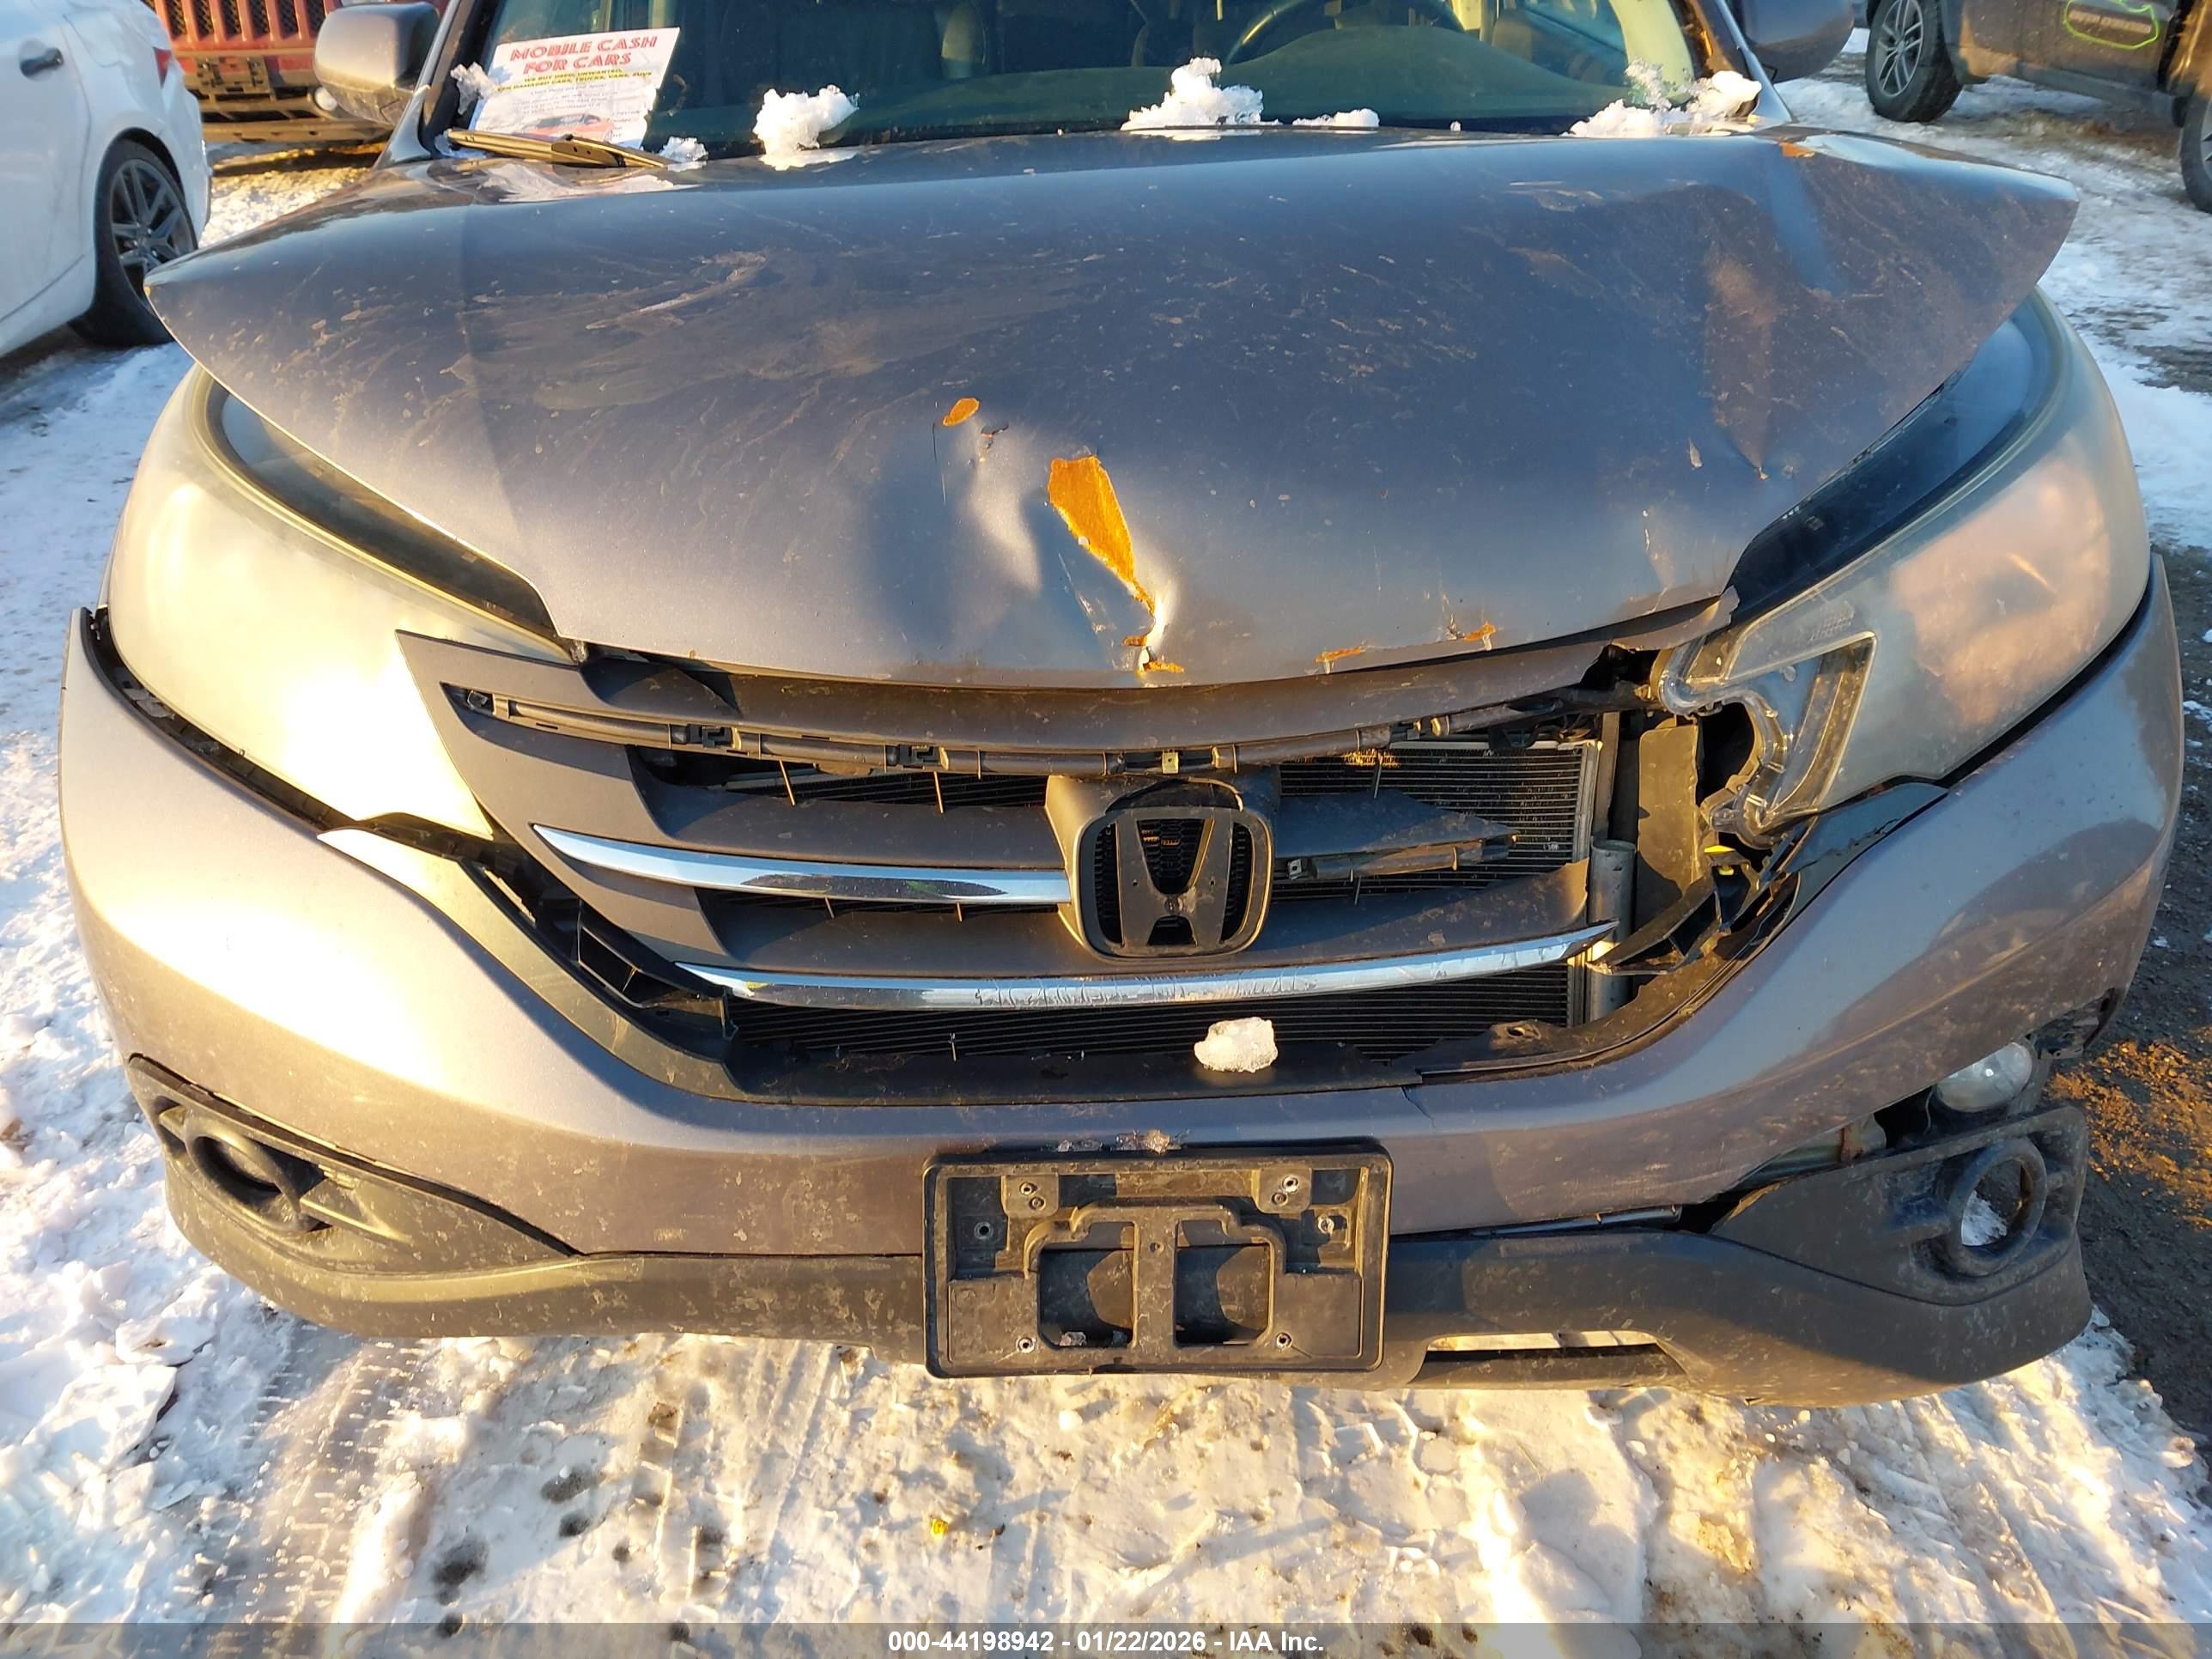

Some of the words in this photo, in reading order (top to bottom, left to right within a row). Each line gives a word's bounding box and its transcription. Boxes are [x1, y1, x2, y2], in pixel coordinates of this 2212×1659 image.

[510, 40, 591, 62] MOBILE
[597, 36, 657, 52] CASH
[523, 58, 567, 75] FOR
[573, 52, 632, 70] CARS
